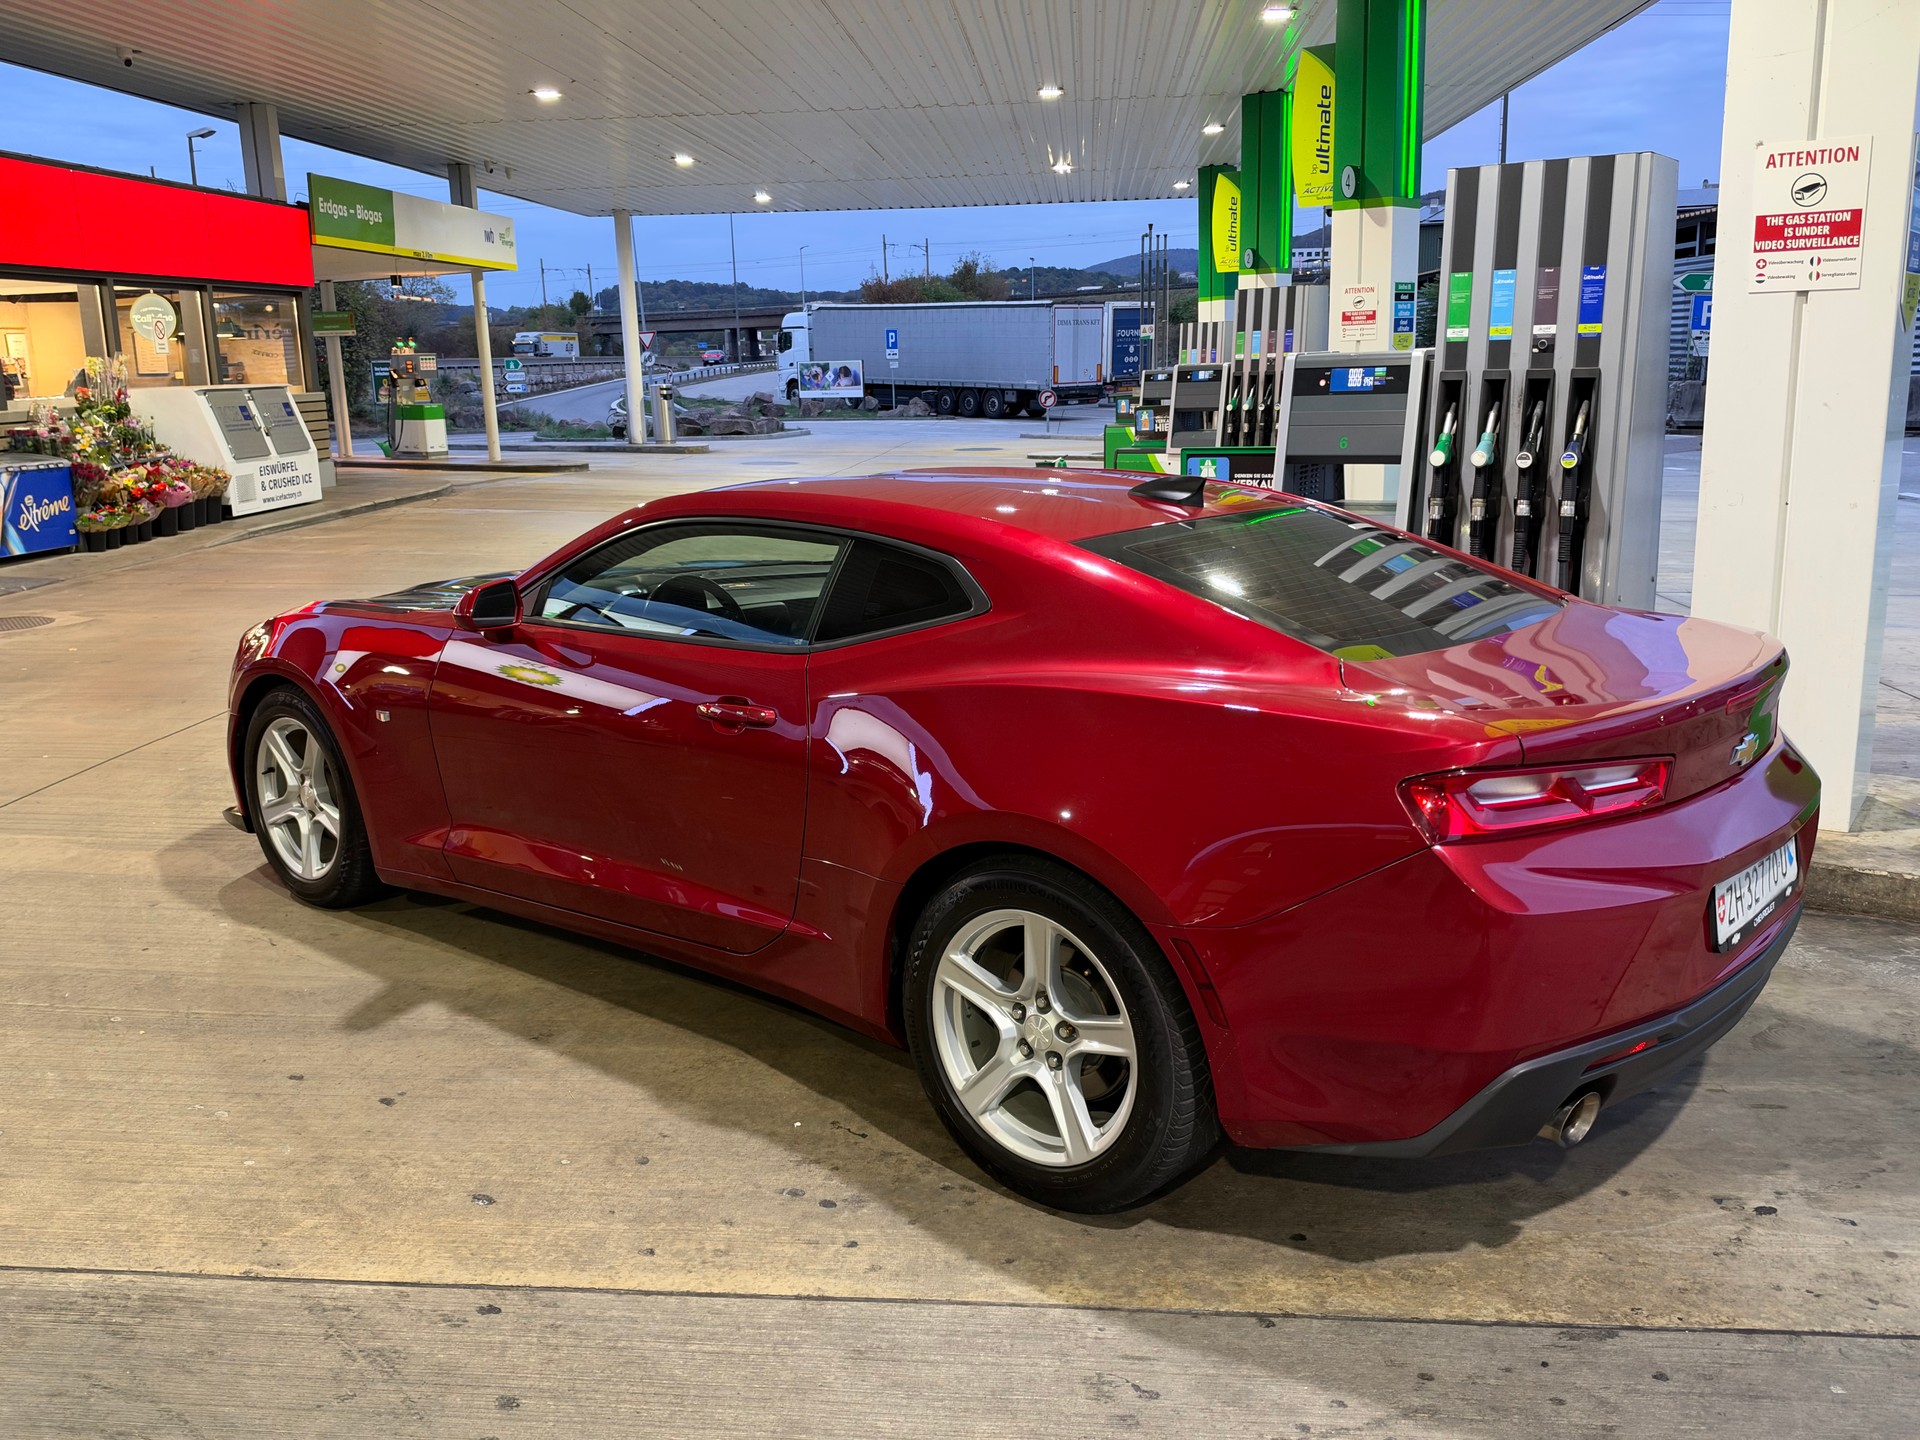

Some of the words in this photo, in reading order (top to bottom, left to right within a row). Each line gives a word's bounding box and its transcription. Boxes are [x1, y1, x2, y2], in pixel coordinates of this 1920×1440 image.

[1315, 85, 1332, 174] ultimate
[1766, 146, 1860, 169] ATTENTION
[1311, 163, 1318, 175] bp
[1345, 173, 1350, 190] 4
[318, 197, 348, 220] Erdgas
[356, 204, 383, 225] Biogas
[1766, 216, 1784, 227] THE
[1786, 214, 1806, 226] GAS
[1807, 211, 1852, 224] STATION
[1228, 196, 1238, 252] ultimate
[1784, 227, 1794, 237] IS
[1795, 225, 1830, 237] UNDER
[1755, 240, 1785, 251] VIDEO
[1786, 235, 1860, 250] SURVEILLANCE
[1246, 253, 1251, 264] 2
[1344, 286, 1375, 295] ATTENTION
[1057, 319, 1072, 327] DIMA
[887, 332, 896, 348] P
[1154, 424, 1170, 432] HIE
[1339, 436, 1348, 449] 6
[259, 461, 299, 477] EISWÜRFEL
[261, 481, 267, 492] &
[268, 475, 301, 491] CRUSHED
[301, 473, 313, 485] ICE
[1232, 479, 1274, 489] ERKAU
[262, 490, 303, 503] www.icefactory.ch
[1753, 901, 1776, 927] CHEVROLET
